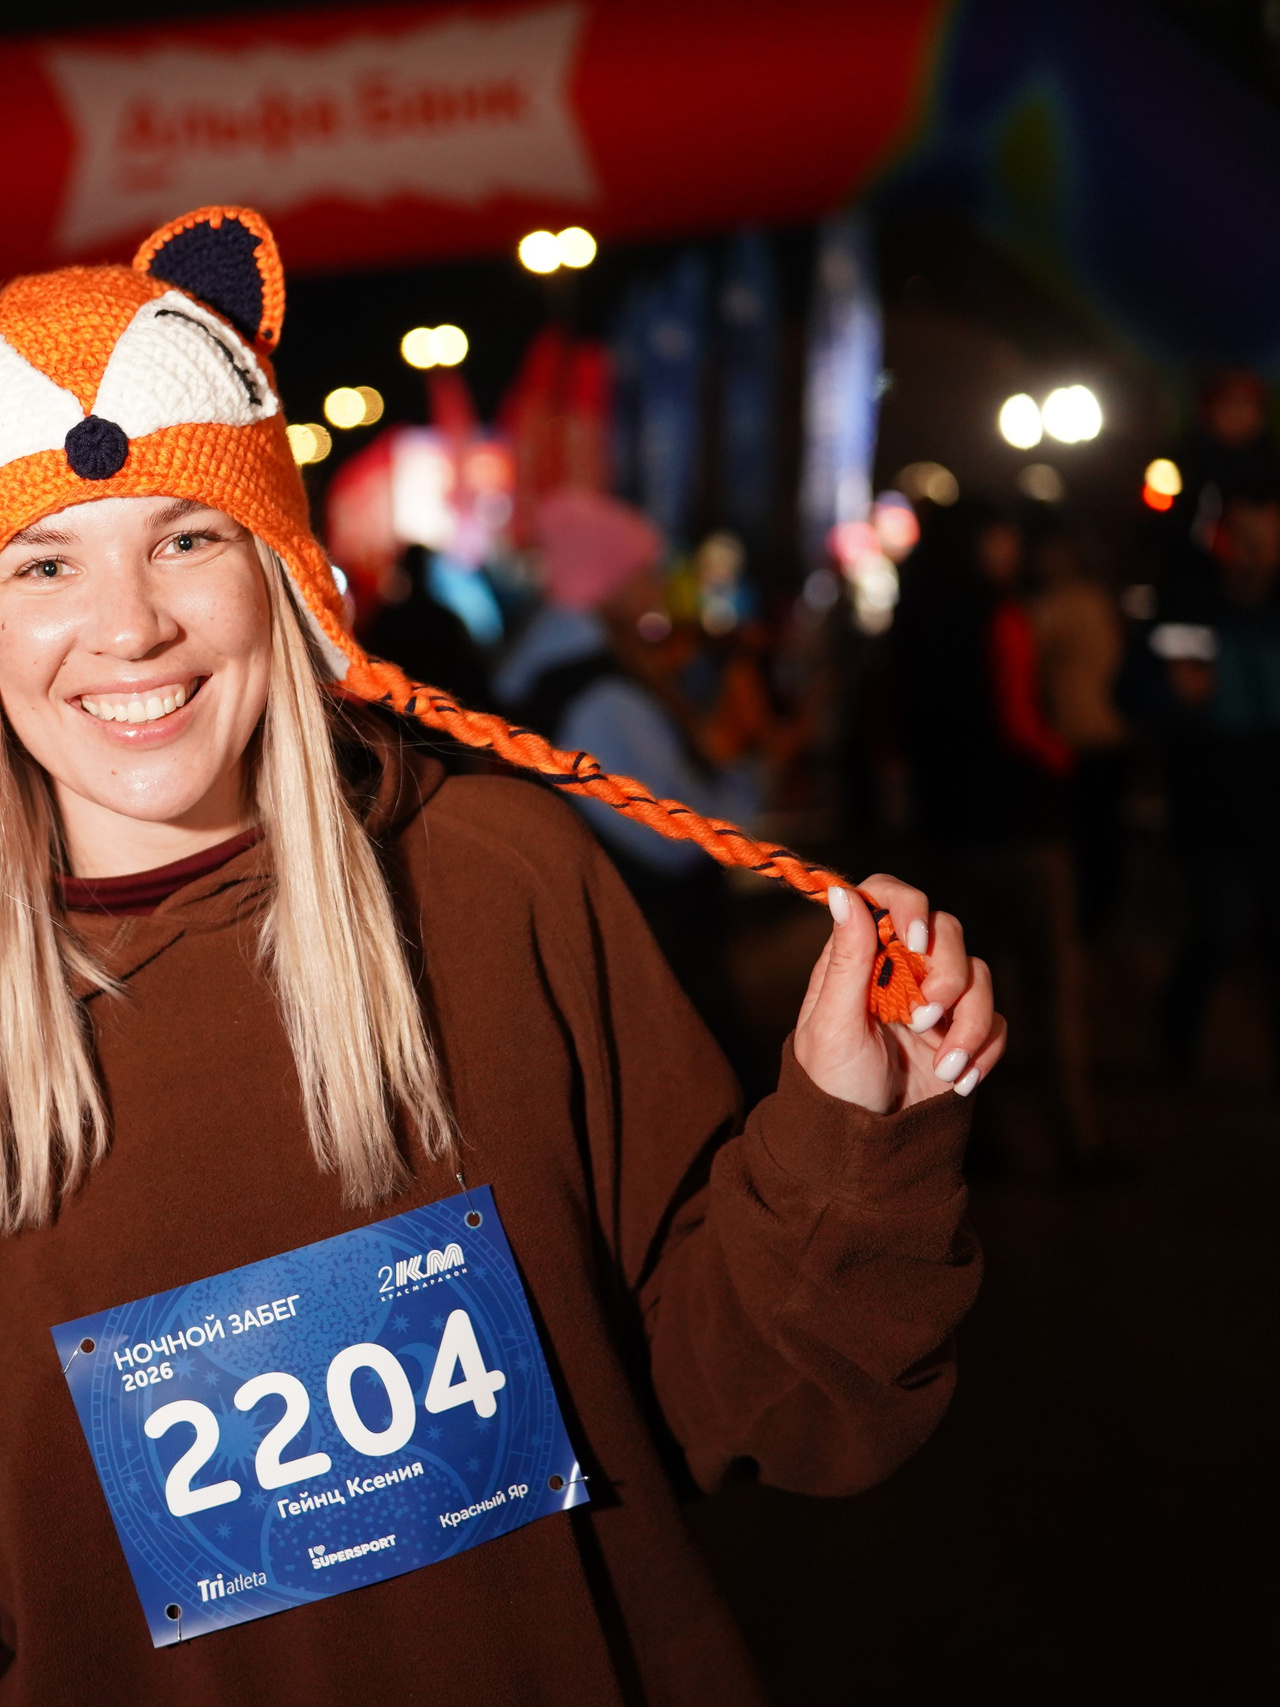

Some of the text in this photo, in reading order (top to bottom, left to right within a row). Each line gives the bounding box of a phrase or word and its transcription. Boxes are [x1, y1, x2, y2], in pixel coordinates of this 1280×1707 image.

[380, 1267, 468, 1303] КРАСМАРАФОН
[113, 1294, 300, 1371] НОЧНОЙ ЗАБЕГ
[122, 1361, 174, 1392] 2026
[143, 1308, 507, 1518] 2204
[276, 1461, 425, 1519] Гейнц Ксения
[439, 1482, 530, 1529] Красный Яр
[311, 1534, 397, 1570] SUPERSPORT
